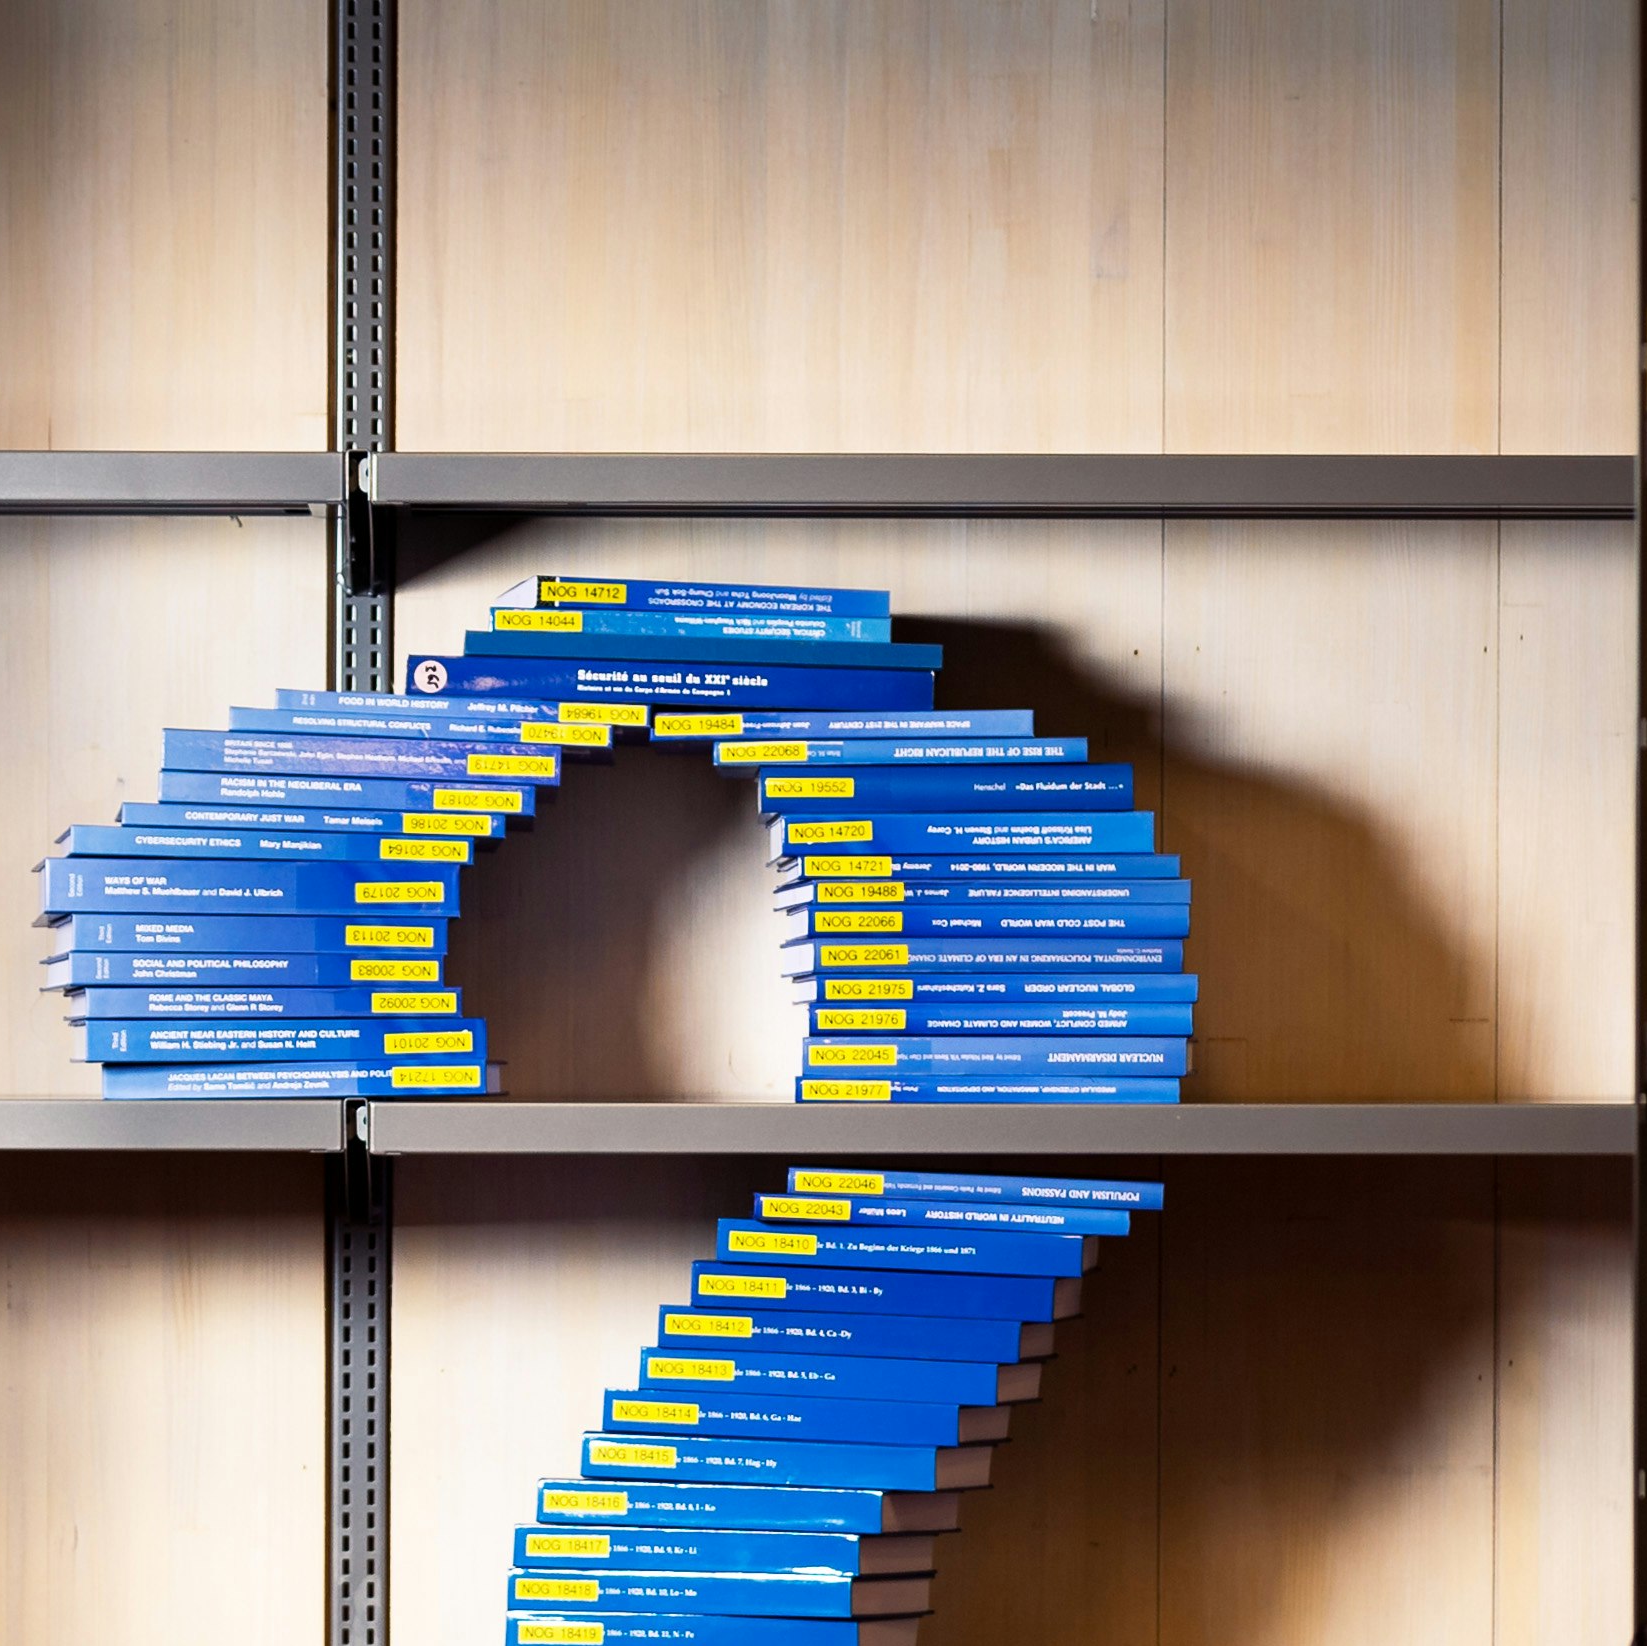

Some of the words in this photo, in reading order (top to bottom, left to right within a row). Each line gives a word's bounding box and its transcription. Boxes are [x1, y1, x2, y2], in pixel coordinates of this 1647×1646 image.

[547, 585, 577, 597] NOG
[585, 587, 620, 599] 14712
[502, 614, 532, 626] NOG
[539, 615, 576, 627] 14044
[578, 669, 628, 683] Sécurité
[633, 674, 647, 683] au
[652, 671, 681, 684] seuil
[686, 672, 700, 685] du
[732, 674, 768, 687] siècle
[339, 696, 364, 706] FOOD
[365, 697, 375, 707] IN
[377, 698, 409, 708] WORLD
[411, 699, 448, 710] HISTORY
[566, 708, 602, 720] 19684
[610, 709, 640, 721] NOG
[661, 719, 692, 731] NOG
[699, 718, 736, 731] 19484
[726, 746, 757, 758] NOG
[762, 744, 801, 758] 22068
[894, 747, 924, 759] RIGHT
[926, 746, 983, 758] REPUBLICAN
[986, 746, 1005, 758] THE
[1007, 747, 1021, 757] OF
[1022, 746, 1042, 756] RISE
[1045, 747, 1064, 757] THE
[772, 781, 803, 793] NOG
[810, 781, 847, 793] 19552
[485, 796, 514, 807] NOG
[185, 811, 258, 822] CONTEMPORARY
[260, 814, 282, 822] JUST
[284, 814, 304, 823] WAR
[410, 817, 448, 831] 20186
[454, 819, 484, 831] NOG
[794, 828, 825, 839] NOG
[830, 825, 865, 837] 14720
[135, 835, 207, 846] CYBERSECURITY
[209, 838, 241, 847] ETHICS
[973, 836, 1010, 845] HISTORY
[1012, 835, 1043, 845] URBAN
[1044, 835, 1092, 844] AMERICA'S
[388, 844, 425, 856] 20164
[431, 845, 462, 857] NOG
[811, 860, 841, 872] NOG
[849, 860, 883, 872] 14721
[105, 877, 130, 886] WAYS
[132, 877, 144, 886] OF
[146, 877, 166, 886] WAR
[362, 886, 401, 899] 20179
[406, 886, 437, 899] NOG
[822, 915, 852, 928] NOG
[858, 915, 896, 928] 22066
[932, 919, 948, 927] Cox
[950, 919, 981, 927] Michael
[1001, 919, 1033, 928] WORLD
[1035, 919, 1055, 928] WAR
[1057, 919, 1081, 928] COLD
[1083, 919, 1106, 928] POST
[1108, 919, 1125, 928] THE
[352, 930, 391, 943] 20113
[396, 931, 426, 943] NOG
[828, 949, 858, 962] NOG
[864, 948, 900, 961] 22061
[357, 964, 396, 977] 20083
[401, 964, 432, 977] NOG
[831, 983, 863, 996] NOG
[868, 983, 906, 996] 21975
[1025, 984, 1055, 993] ORDER
[1057, 983, 1098, 993] NUCLEAR
[1100, 983, 1135, 993] GLOBAL
[379, 997, 417, 1009] 20092
[420, 997, 450, 1009] NOG
[824, 1013, 855, 1026] NOG
[860, 1013, 899, 1025] 21976
[393, 1037, 430, 1050] 20101
[435, 1036, 466, 1049] NOG
[815, 1049, 846, 1061] NOG
[851, 1048, 890, 1061] 22045
[1048, 1053, 1117, 1063] DISARMAMENT
[1119, 1053, 1163, 1063] NUCLEAR
[399, 1071, 436, 1083] 17214
[443, 1070, 474, 1083] NOG
[809, 1083, 840, 1096] NOG
[845, 1084, 883, 1096] 21977
[802, 1176, 832, 1188] NOG
[839, 1177, 876, 1190] 22046
[1022, 1187, 1066, 1199] PASSIONS
[1069, 1189, 1090, 1200] AND
[1092, 1190, 1139, 1202] POPULISM
[769, 1202, 799, 1214] NOG
[806, 1203, 843, 1216] 22043
[925, 1209, 963, 1220] HISTORY
[965, 1211, 997, 1222] WORLD
[999, 1213, 1009, 1222] IN
[1011, 1214, 1064, 1225] NEUTRALITY
[735, 1236, 765, 1248] NOG
[774, 1238, 810, 1250] 18410
[706, 1279, 735, 1290] NOG
[743, 1281, 777, 1292] 18411
[672, 1319, 701, 1331] NOG
[709, 1321, 745, 1332] 18412
[655, 1363, 684, 1374] NOG
[692, 1364, 727, 1375] 18413
[620, 1405, 648, 1416] NOG
[657, 1407, 691, 1418] 18414
[597, 1447, 627, 1460] NOG
[634, 1449, 669, 1463] 18415
[550, 1495, 579, 1507] NOG
[586, 1495, 620, 1509] 18416
[532, 1539, 561, 1551] NOG
[568, 1539, 603, 1552] 18417
[521, 1582, 550, 1595] NOG
[557, 1583, 592, 1597] 18418
[525, 1626, 554, 1639] NOG
[561, 1627, 597, 1640] 18419
